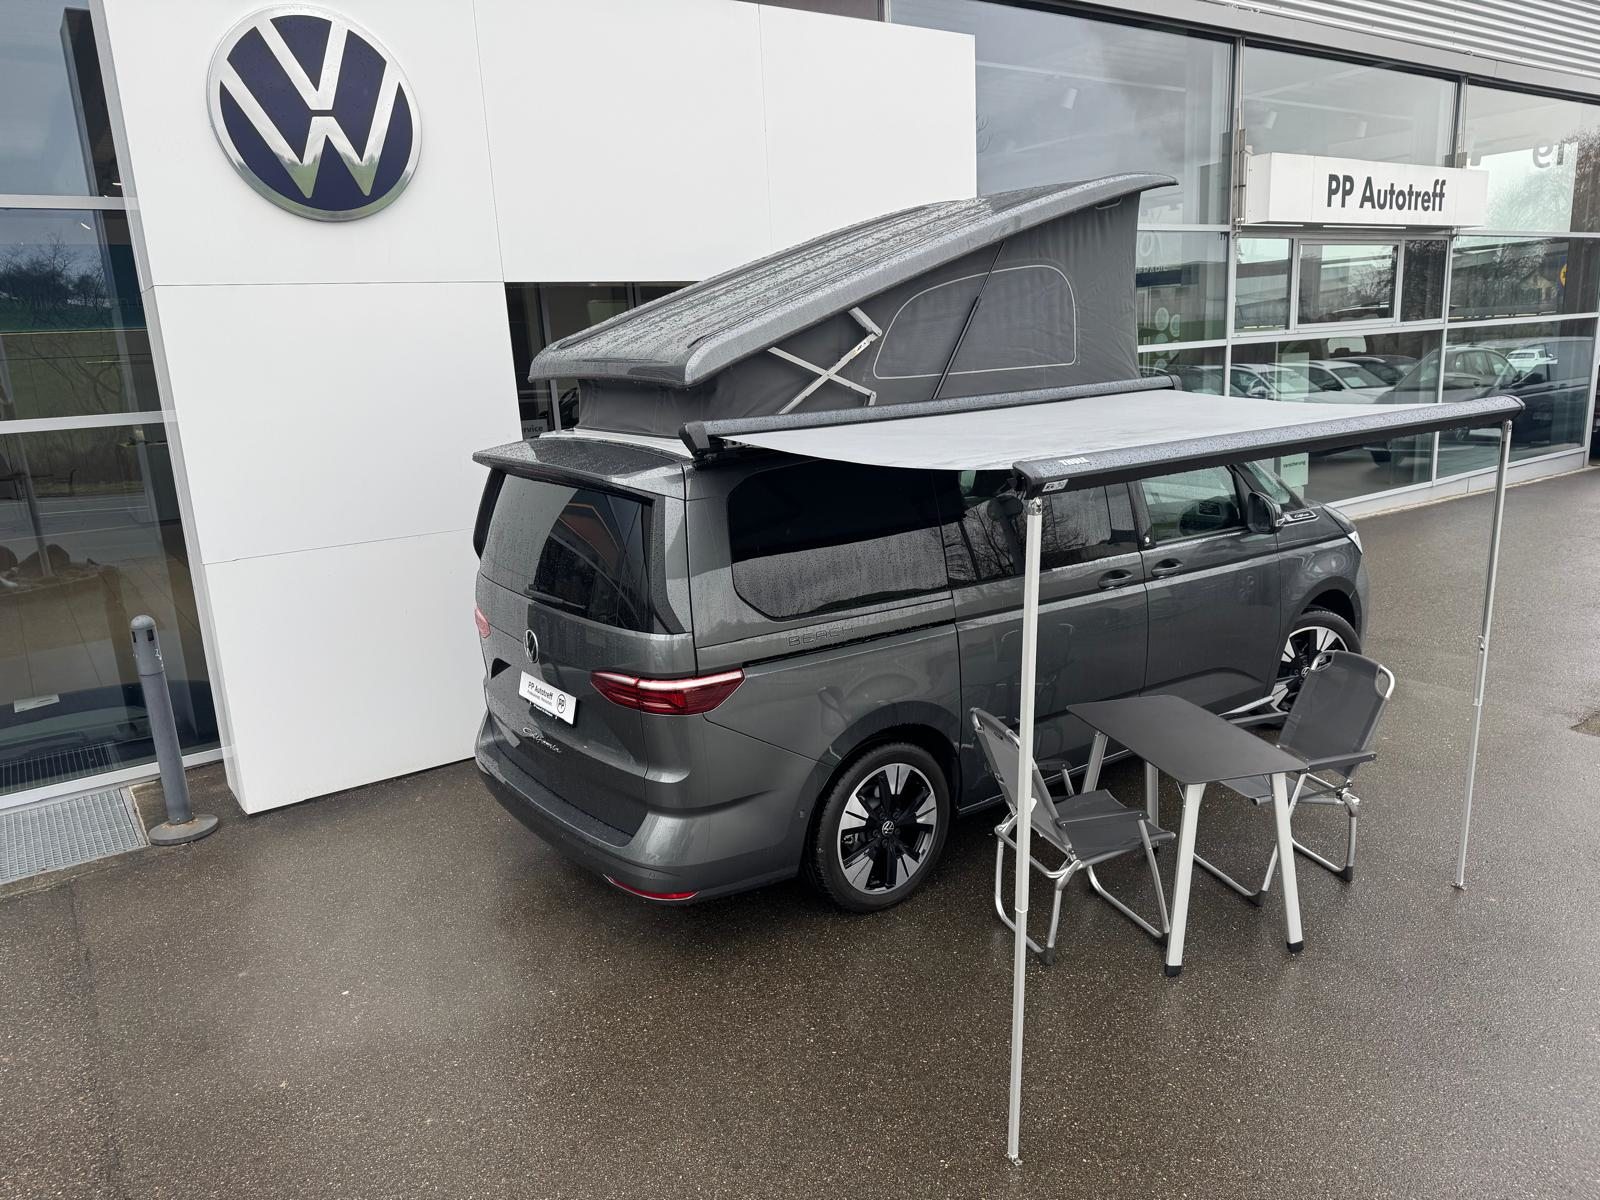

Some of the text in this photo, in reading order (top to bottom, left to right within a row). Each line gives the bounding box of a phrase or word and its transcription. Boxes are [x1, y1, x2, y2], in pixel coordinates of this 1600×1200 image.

[1327, 173, 1447, 212] PP Autotreff
[788, 624, 854, 647] BEACH
